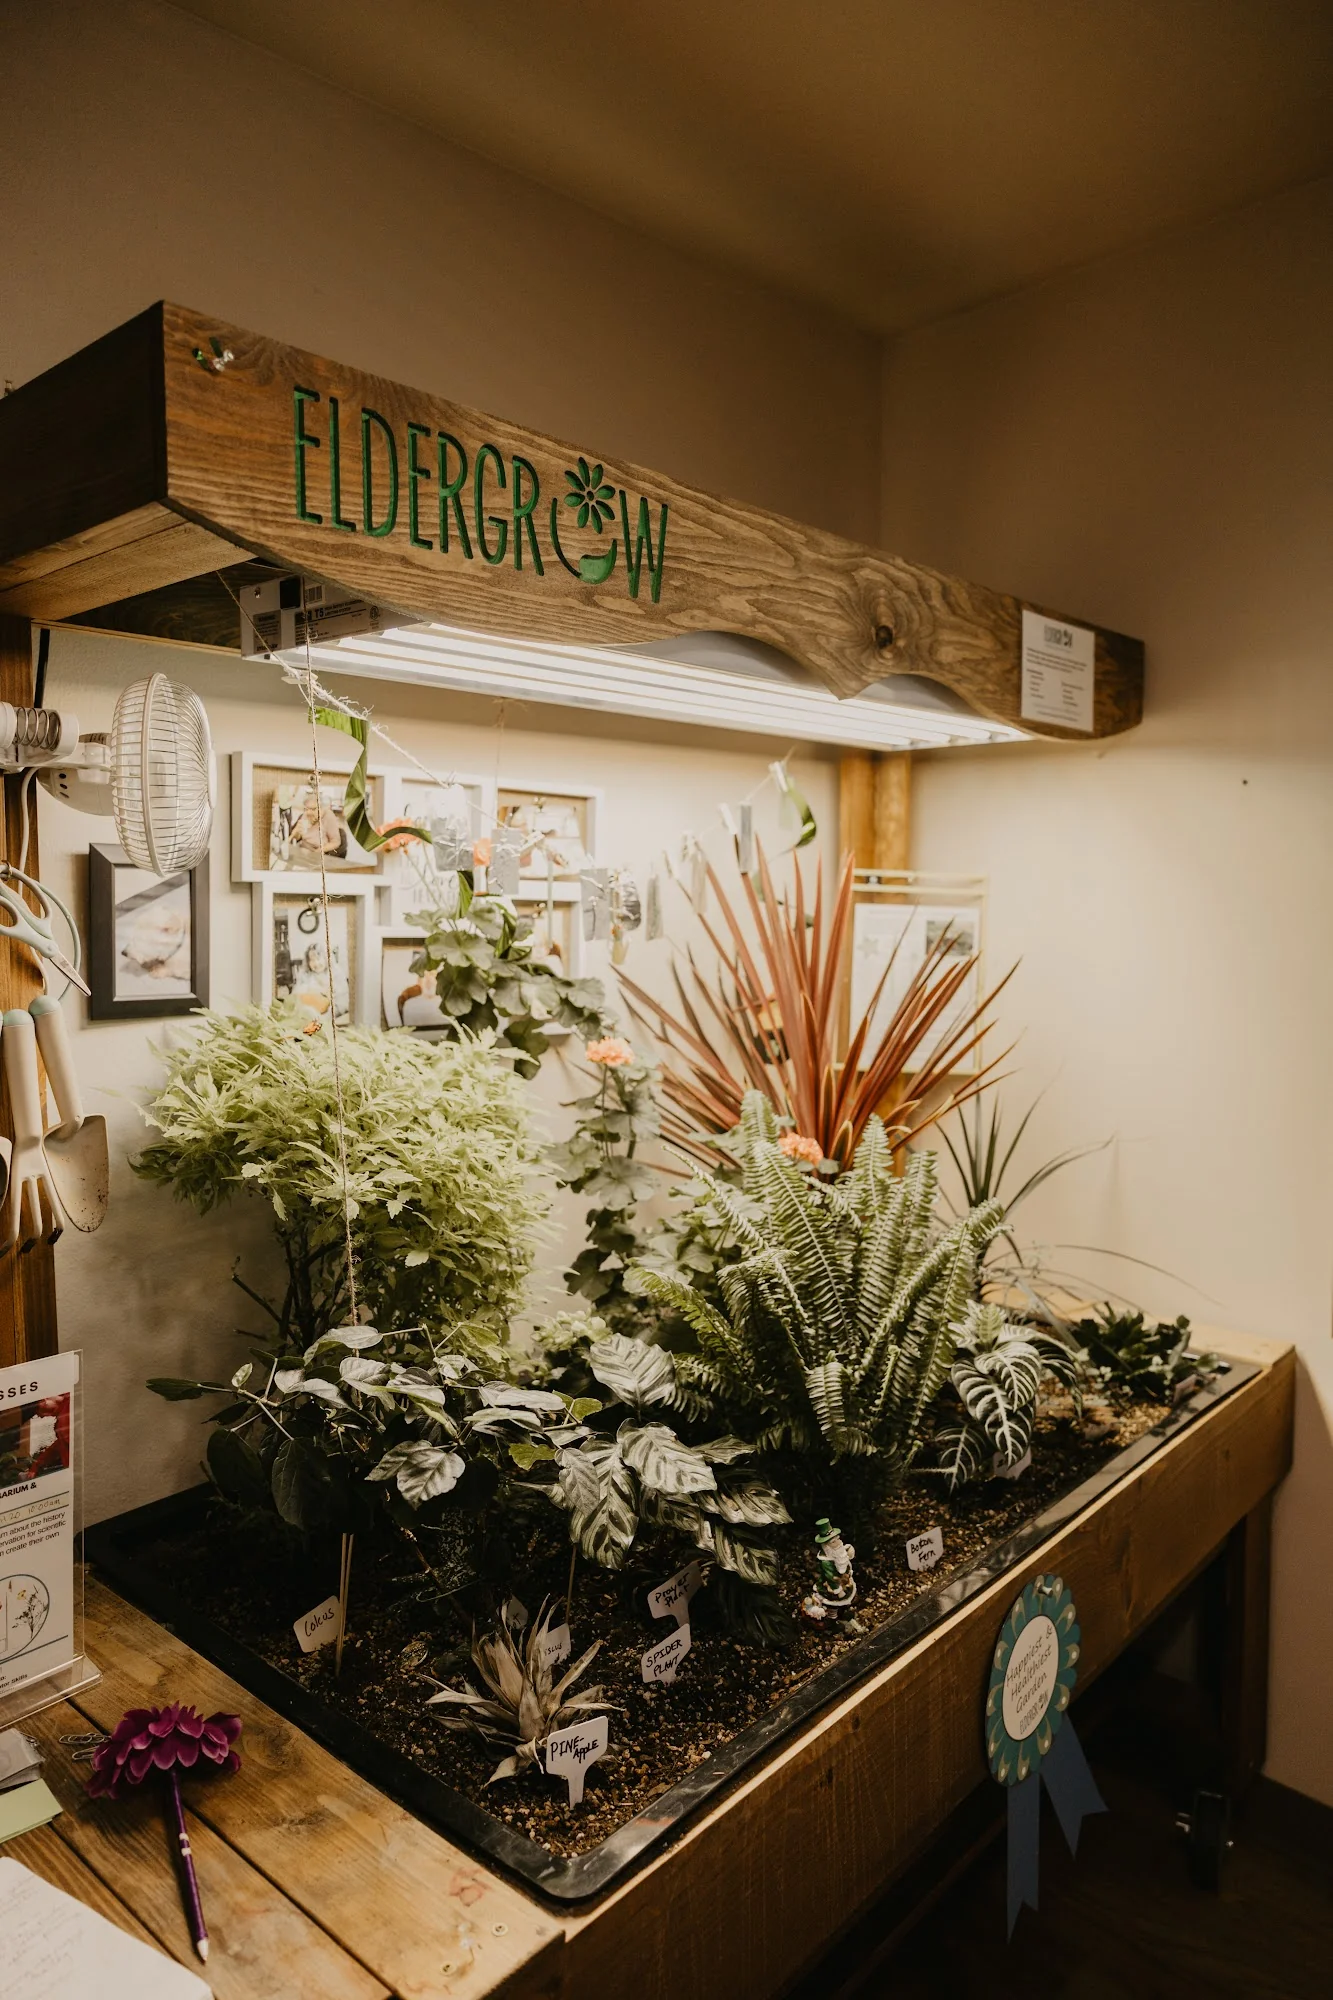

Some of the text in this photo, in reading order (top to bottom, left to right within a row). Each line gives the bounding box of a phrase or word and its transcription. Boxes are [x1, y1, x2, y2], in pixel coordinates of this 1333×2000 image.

[30, 1481, 37, 1489] &
[9, 1523, 30, 1535] about
[30, 1520, 42, 1528] the
[42, 1511, 66, 1524] history
[37, 1519, 67, 1534] scientific
[5, 1541, 28, 1556] create
[28, 1535, 44, 1547] their
[45, 1531, 60, 1541] own
[645, 1639, 683, 1668] SPIDER
[653, 1652, 680, 1678] PLANT
[1006, 1624, 1053, 1687] Happiest &
[11, 1673, 28, 1684] Skills
[1011, 1644, 1052, 1702] Healthiest
[1015, 1672, 1047, 1714] Garden
